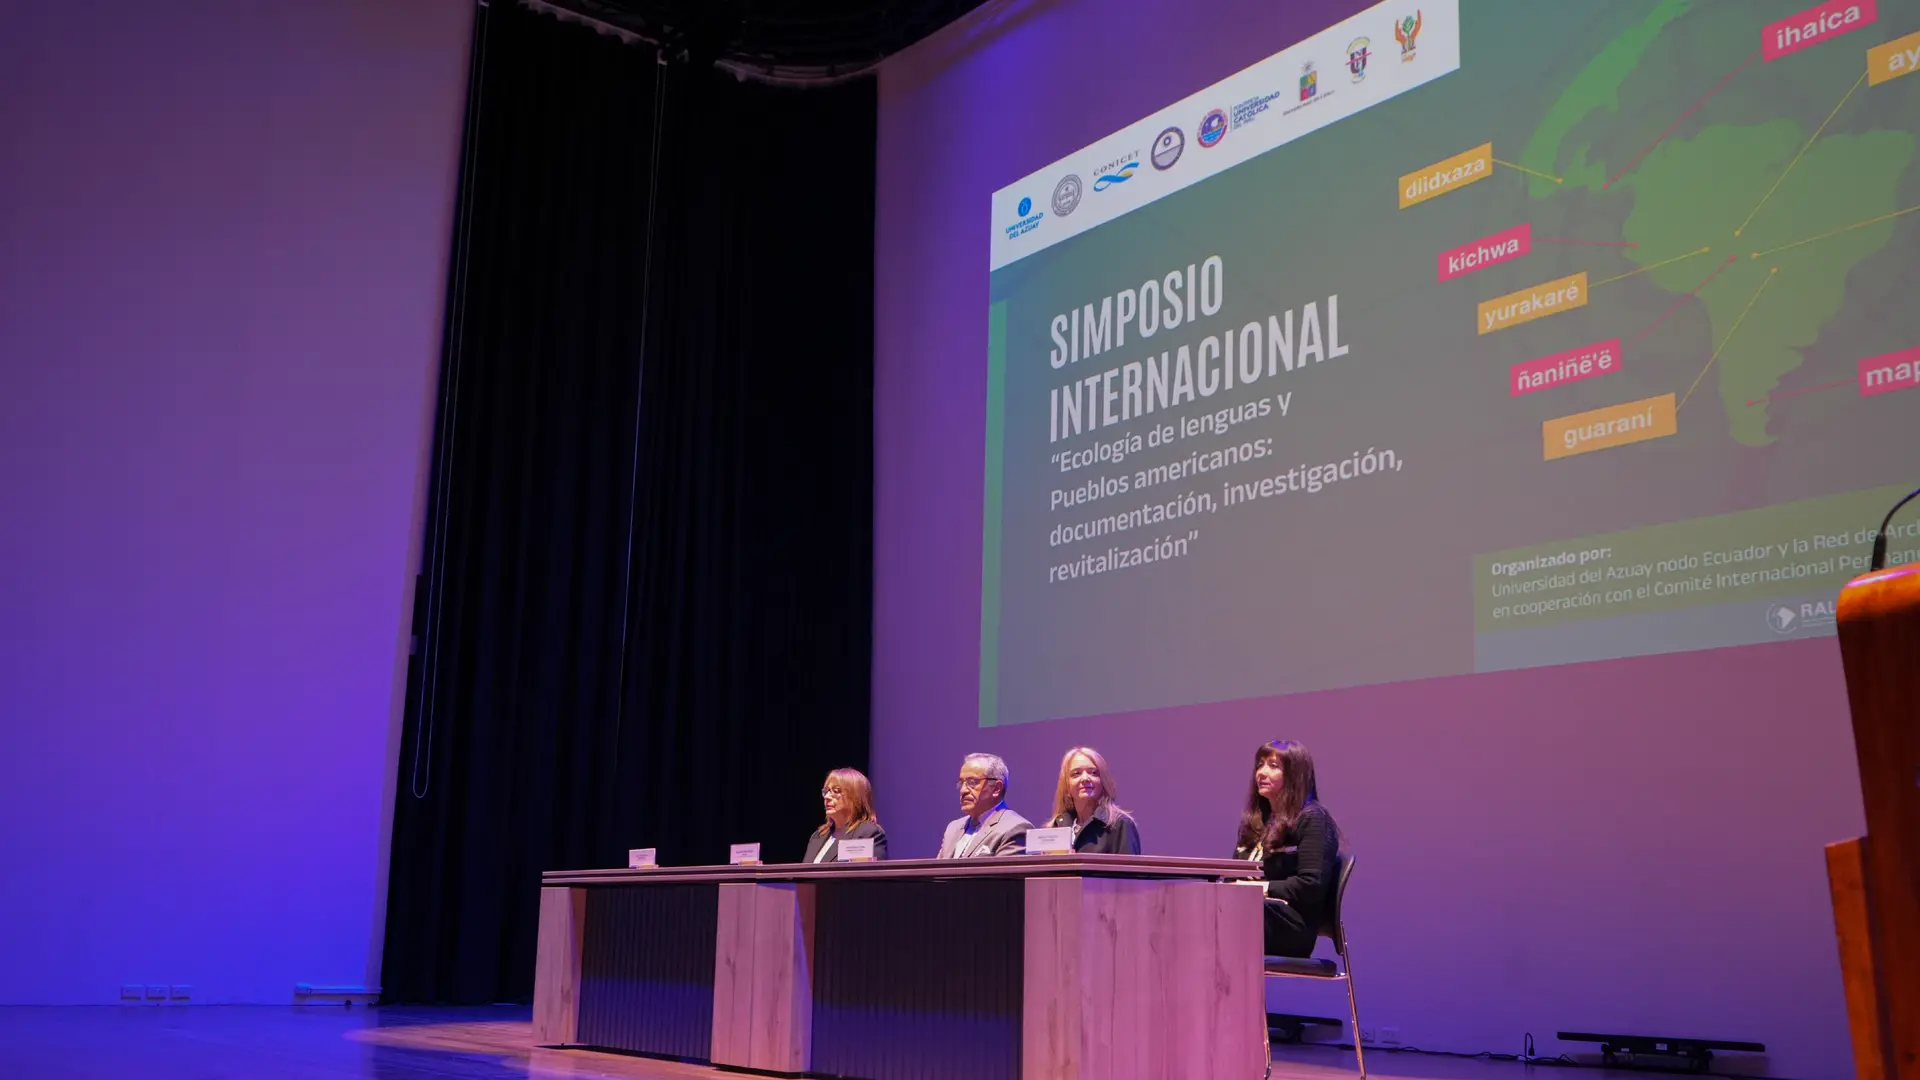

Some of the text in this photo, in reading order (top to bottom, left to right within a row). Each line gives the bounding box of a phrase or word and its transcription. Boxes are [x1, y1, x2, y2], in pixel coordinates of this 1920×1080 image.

[1777, 5, 1860, 49] ihaíca
[1093, 150, 1140, 176] CONICET
[1406, 159, 1485, 199] diidxaza
[1005, 212, 1043, 233] UNIVERSIDAD
[1448, 239, 1519, 274] kichwa
[1050, 255, 1223, 369] SIMPOSIO
[1485, 281, 1579, 329] yurakaré
[1050, 294, 1349, 442] INTERNACIONAL
[1148, 424, 1174, 449] de
[1180, 397, 1271, 439] lenguas
[1278, 391, 1292, 416] y
[1564, 406, 1653, 449] guaraní
[1049, 446, 1403, 546] documentación, investigación,
[1050, 438, 1273, 511] Pueblos americanos:
[1491, 547, 1612, 577] Organizado por:
[1492, 519, 1920, 597] Universidad del Azuay nodo Ecuador y la Red de Arc
[1493, 606, 1510, 619] en
[1513, 591, 1601, 615] cooperación
[1605, 589, 1632, 604] con
[1637, 584, 1650, 599] el
[1654, 576, 1713, 597] Comité
[1716, 557, 1834, 587] Internacional
